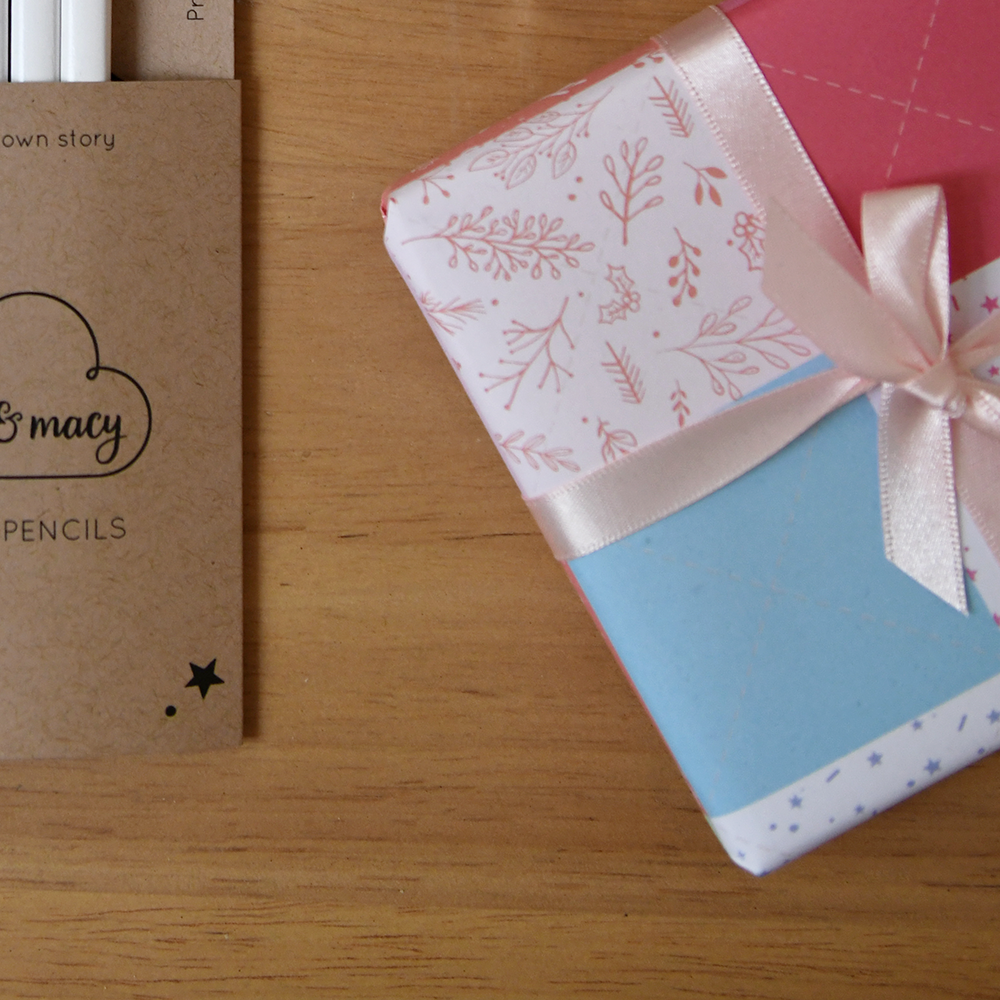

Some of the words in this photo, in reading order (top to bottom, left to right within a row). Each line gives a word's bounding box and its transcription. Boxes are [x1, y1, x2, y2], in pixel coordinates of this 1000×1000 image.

[1, 133, 49, 149] own
[57, 129, 116, 152] story
[29, 411, 127, 465] macy
[3, 516, 127, 542] PENCILS
